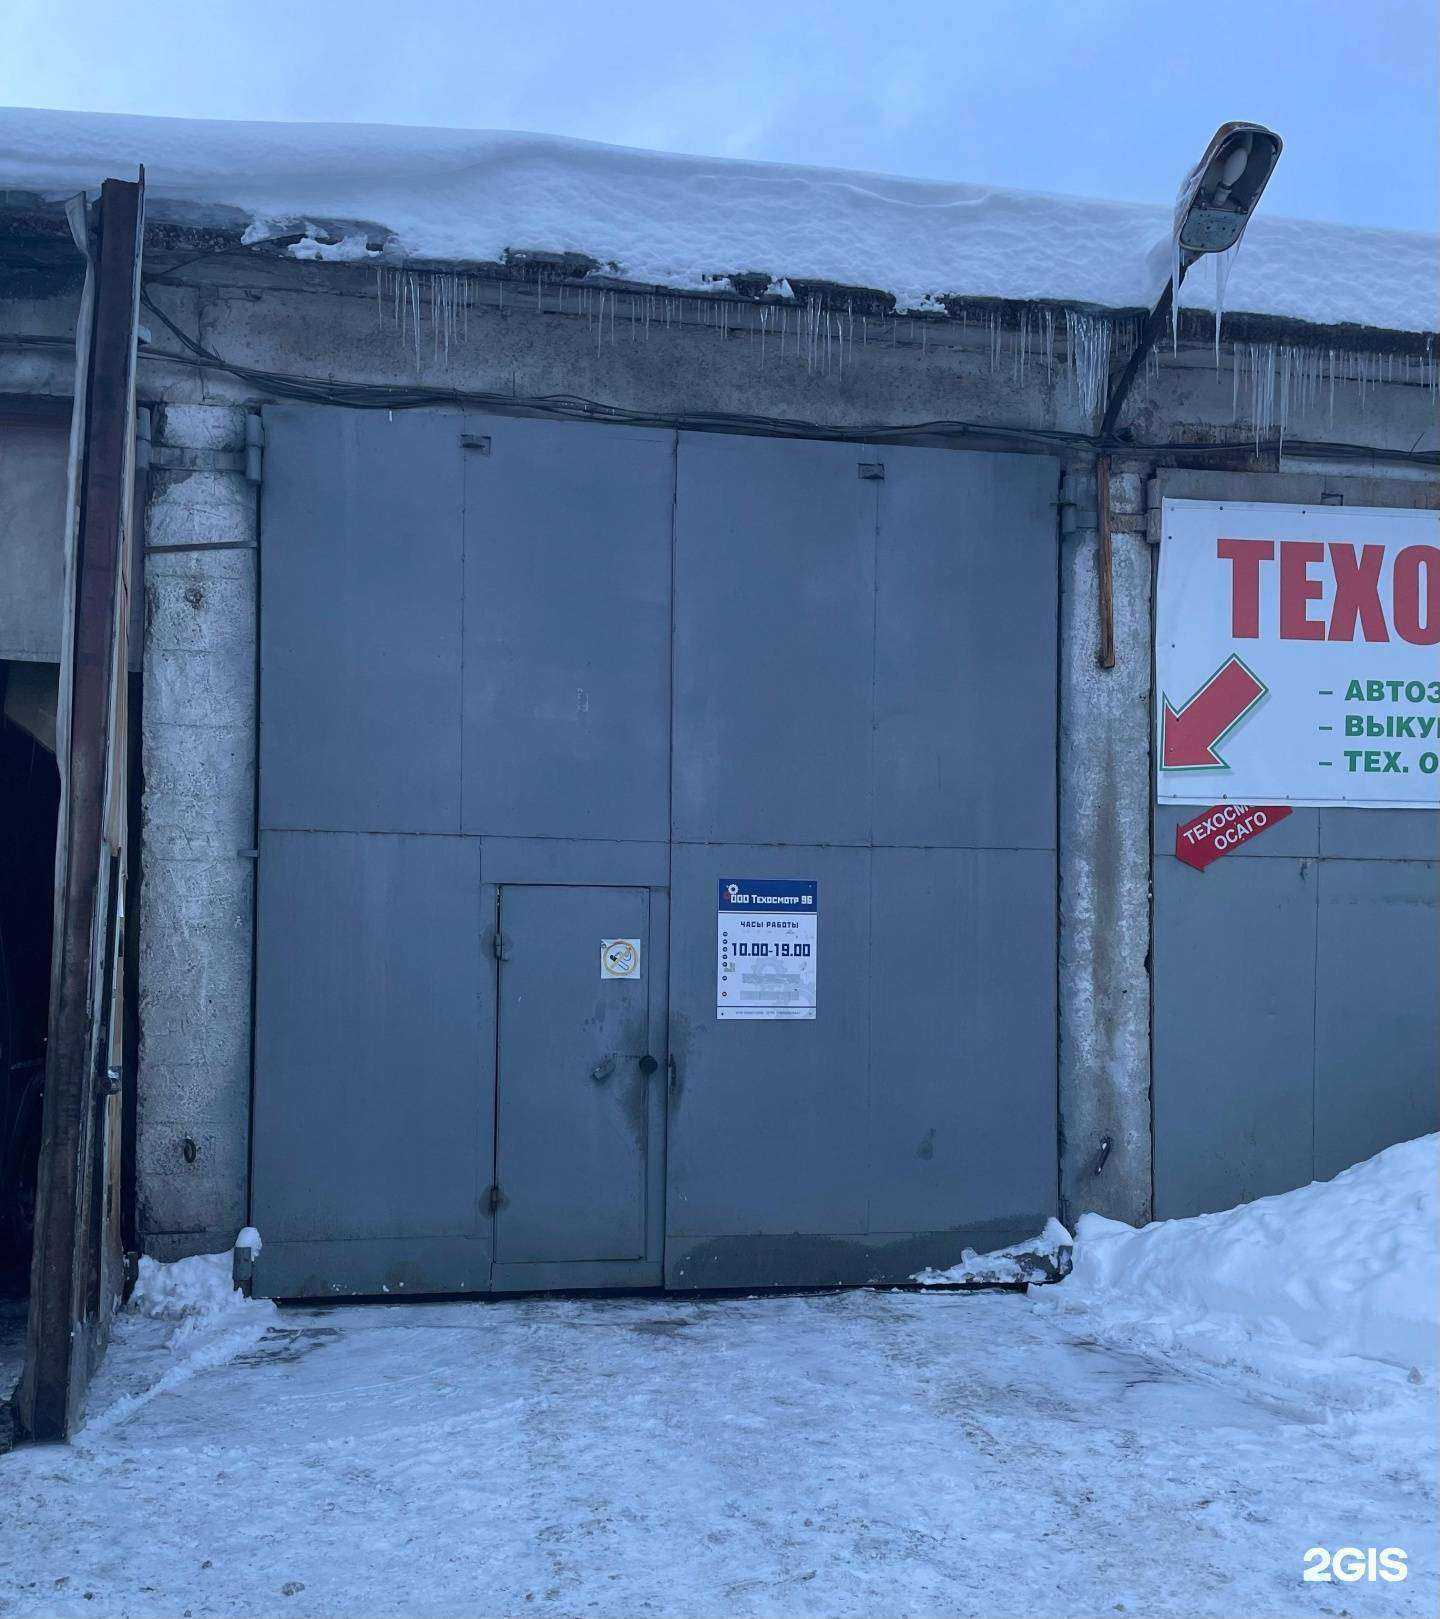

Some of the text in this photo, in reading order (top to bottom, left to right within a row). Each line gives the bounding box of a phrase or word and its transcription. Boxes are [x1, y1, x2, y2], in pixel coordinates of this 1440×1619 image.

[1216, 538, 1440, 646] ТЕХО
[1344, 679, 1440, 703] АВТОЗ
[1345, 714, 1440, 739] ВЫКУ
[1343, 750, 1409, 773] ТЕХ.
[1214, 811, 1267, 850] ОСАГО
[730, 894, 750, 904] ООО
[801, 895, 813, 905] 96
[766, 921, 799, 929] РАБОТЫ
[731, 942, 811, 957] 10.00-19.00
